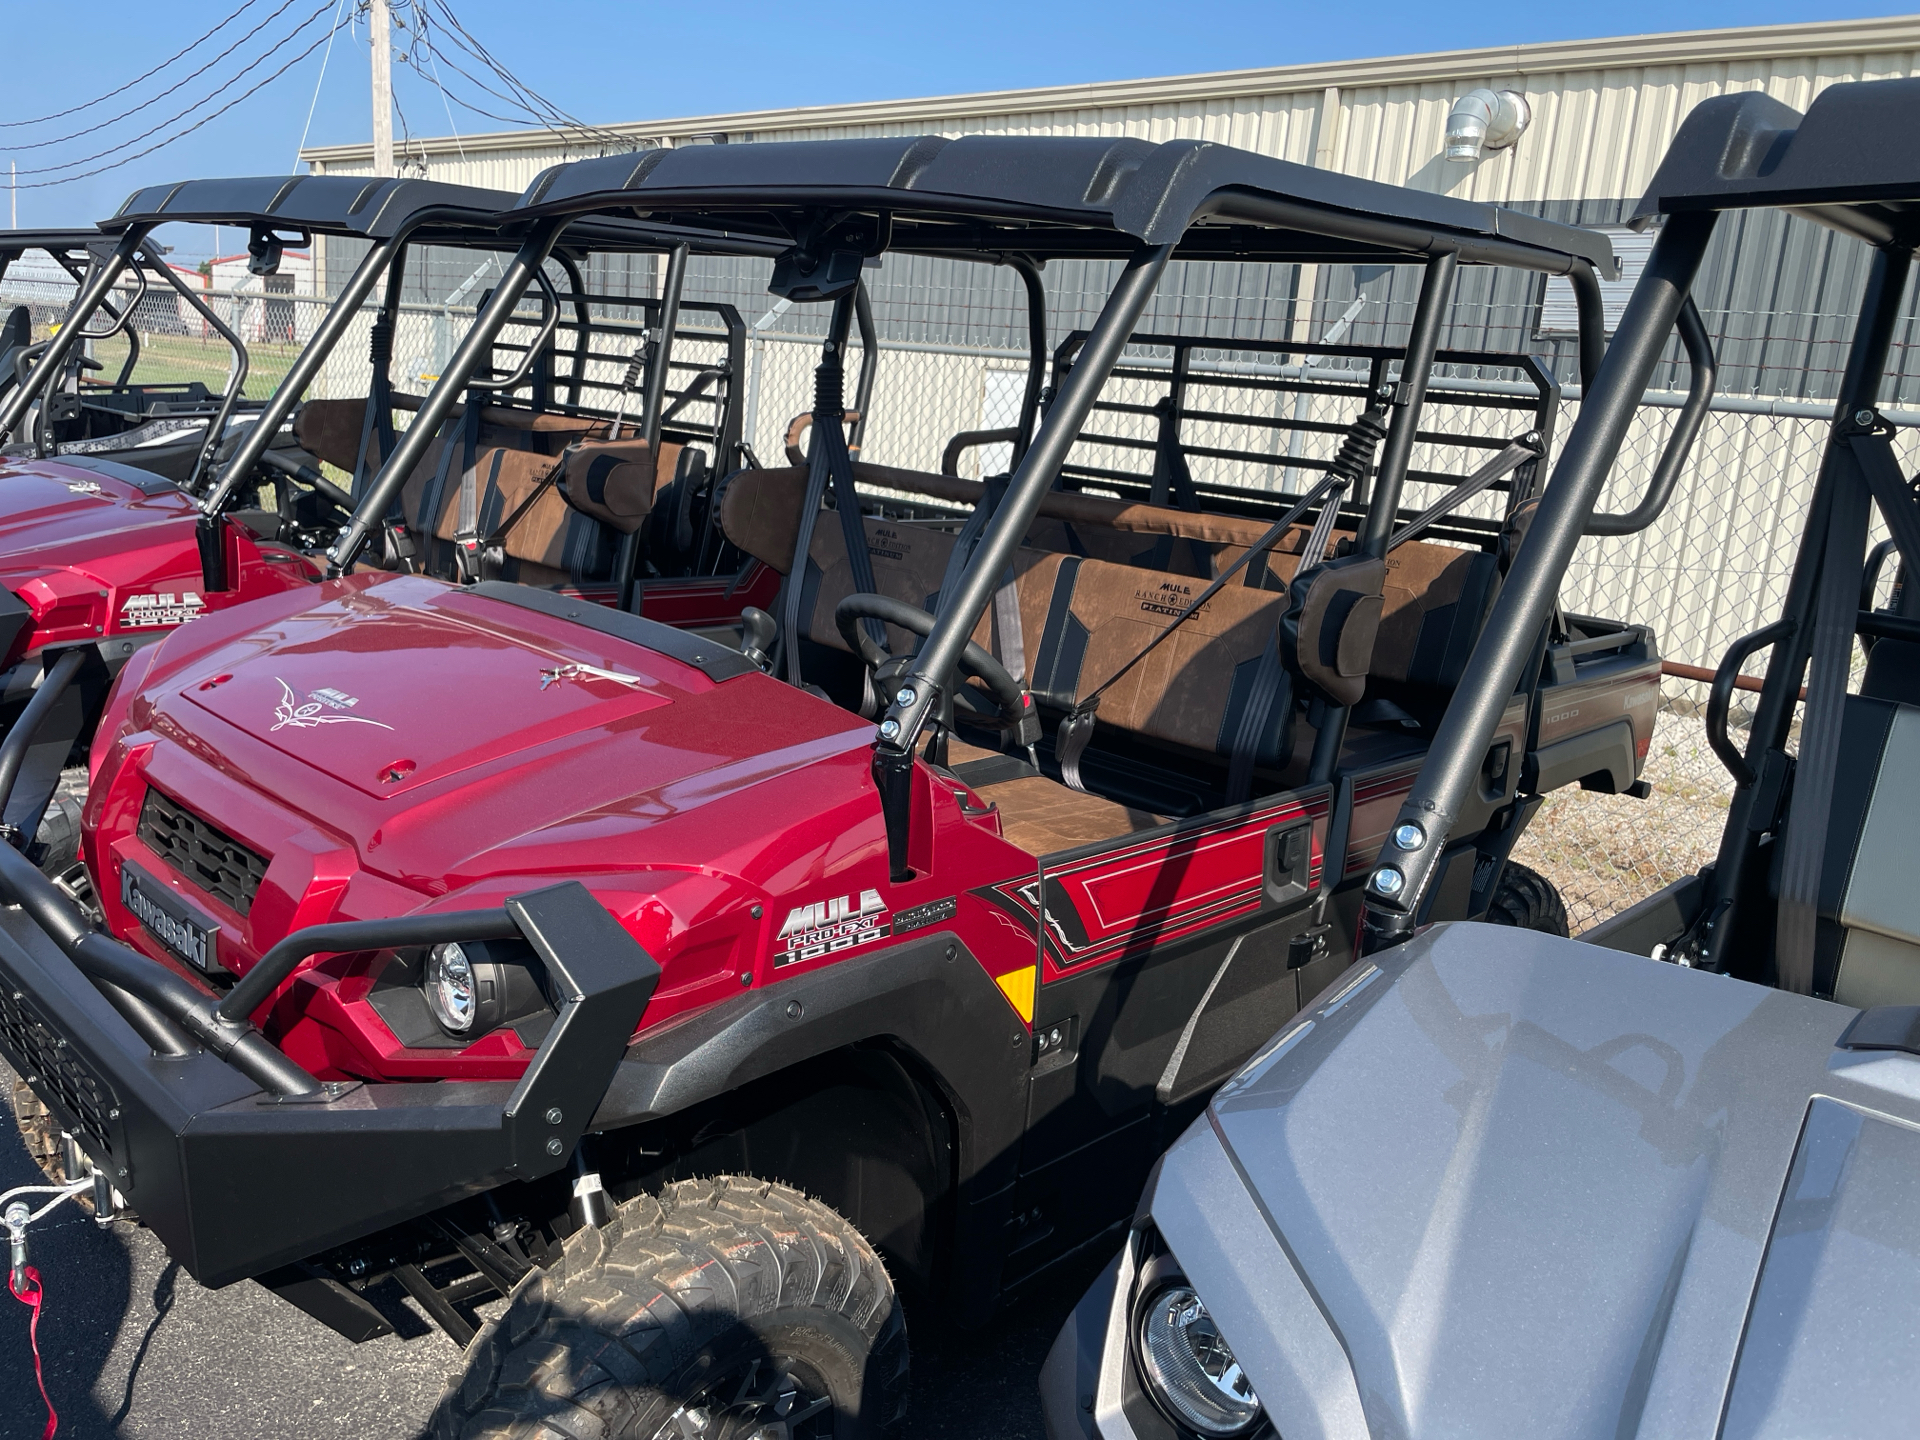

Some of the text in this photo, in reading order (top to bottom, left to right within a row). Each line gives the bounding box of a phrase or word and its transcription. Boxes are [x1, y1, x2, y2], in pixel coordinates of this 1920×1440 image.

[875, 529, 897, 539] MULE
[870, 548, 902, 560] ATINUM
[1159, 583, 1191, 595] MULE
[121, 592, 207, 613] MULE
[1134, 590, 1212, 610] RANCH EDION
[1142, 603, 1198, 619] PLATINM
[1623, 687, 1655, 711] Kawasaki
[1546, 709, 1580, 725] 1000
[122, 869, 207, 969] Kawasaki
[776, 888, 889, 941] MULE
[787, 915, 879, 951] PRO-FXT
[786, 928, 881, 964] 1000
